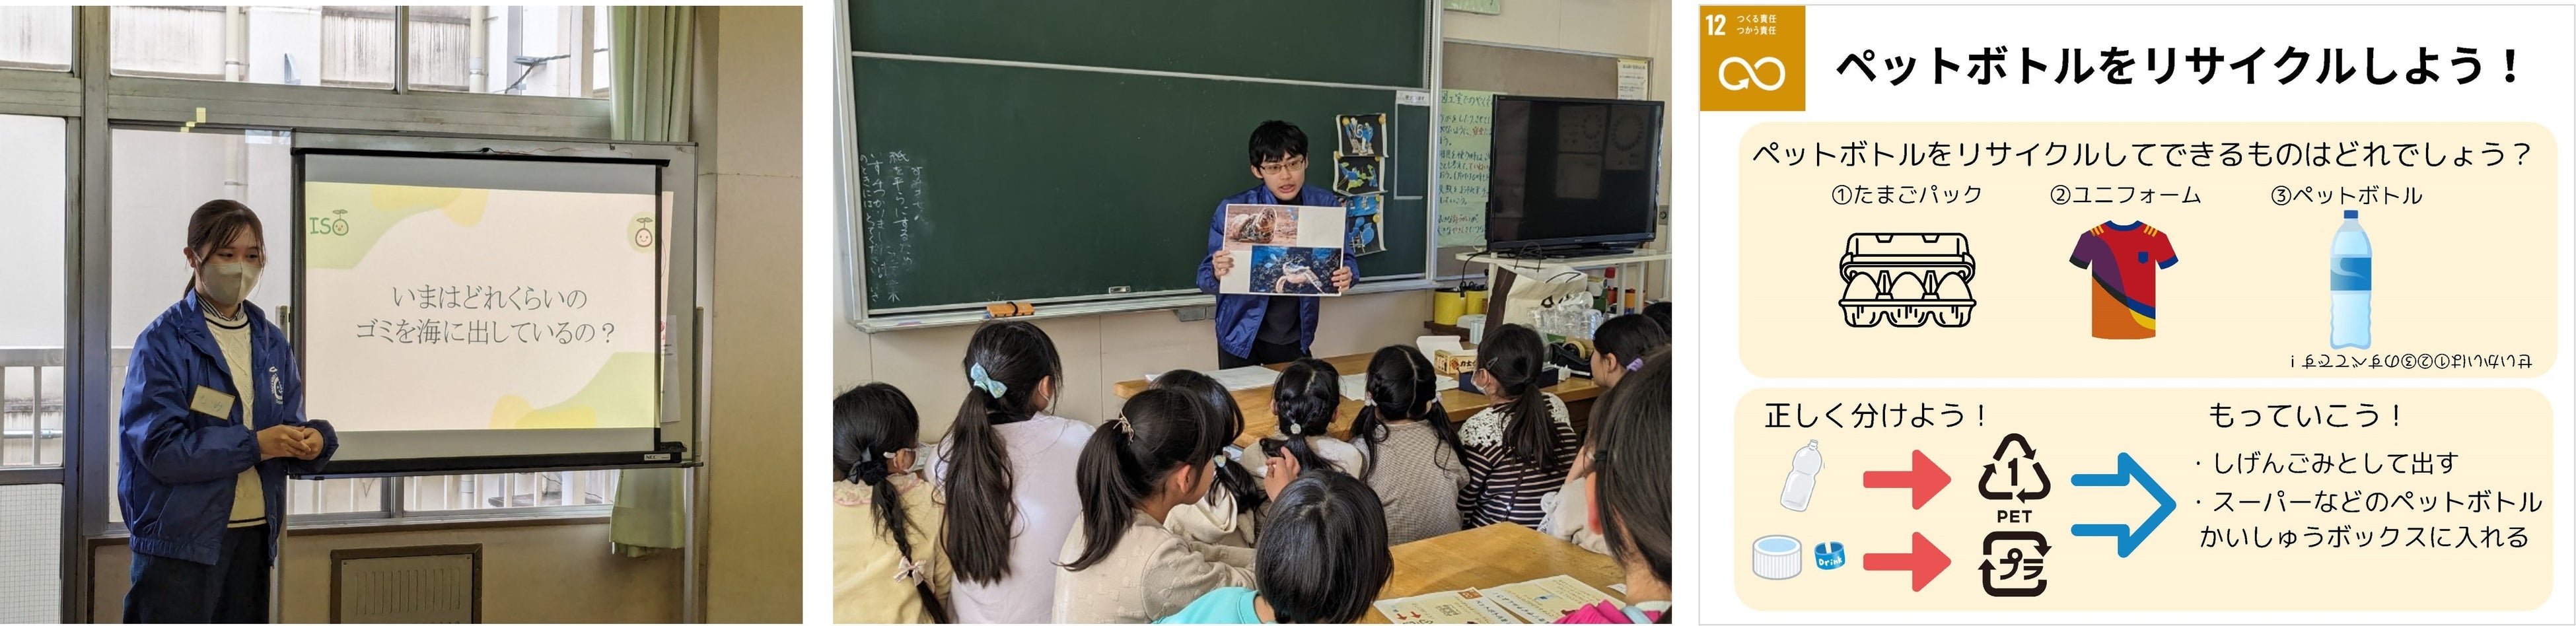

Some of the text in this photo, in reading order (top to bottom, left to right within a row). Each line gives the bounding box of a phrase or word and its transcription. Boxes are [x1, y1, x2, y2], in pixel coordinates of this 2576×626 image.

[1705, 14, 1726, 36] 12
[1736, 14, 1777, 23] つくる責任
[1736, 26, 1777, 35] つかう責任
[1836, 46, 2515, 87] ペットボトルをリサイクルしよう！
[1753, 140, 2531, 168] ペットボトルをリサイクルしてできるものはどれでしょう？
[1832, 185, 1981, 205] ①たまごパック
[2051, 185, 2201, 205] ②ユニフォーム
[2272, 185, 2423, 206] ③ペットボトル
[393, 285, 587, 310] いまはどれくらいの
[357, 318, 615, 345] ゴミを海に出しているの？
[1765, 403, 1984, 429] 正しく分けよう！
[2210, 403, 2398, 428] もっていこう！
[1997, 510, 2032, 523] PET
[2200, 525, 2528, 549] かいしゅうボックスに入れる
[1818, 556, 1842, 567] Drink
[1999, 547, 2044, 580] プラ
